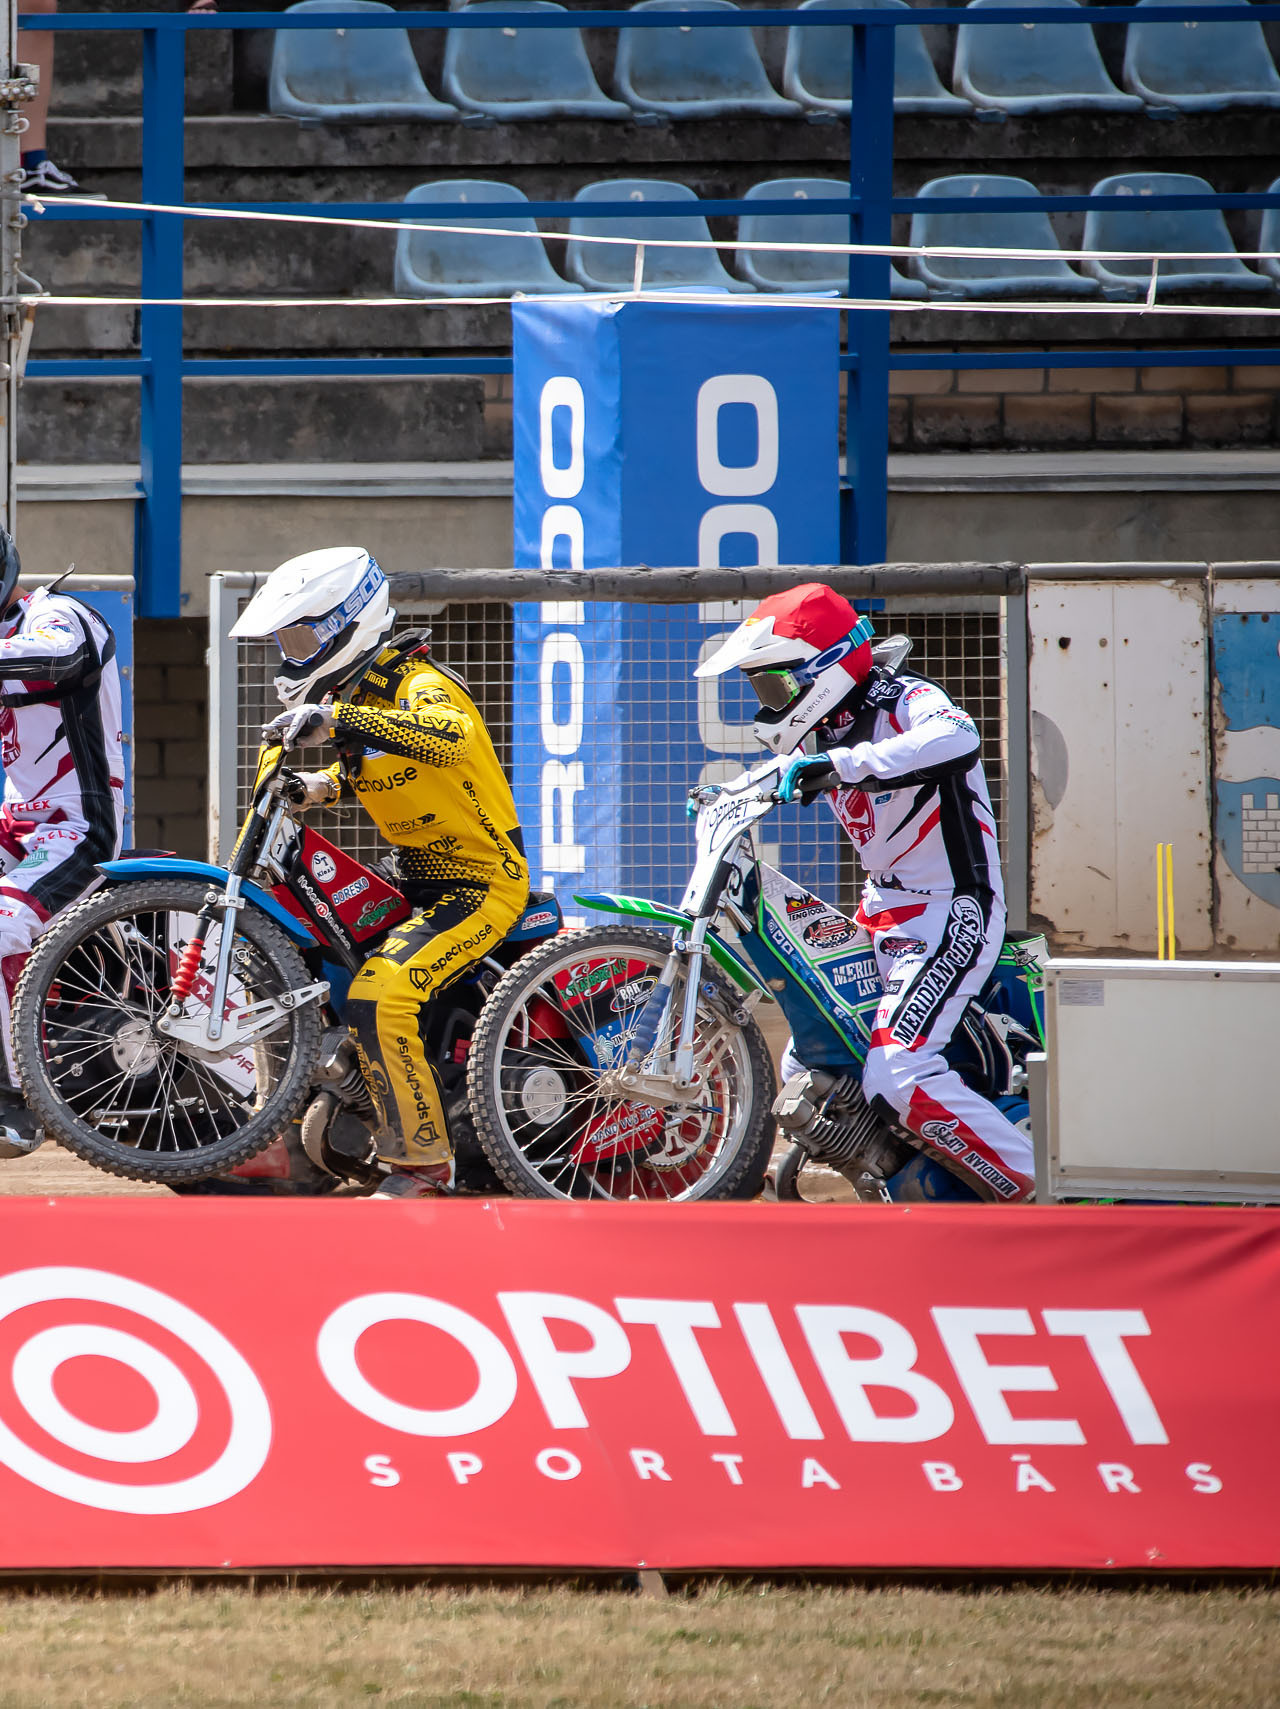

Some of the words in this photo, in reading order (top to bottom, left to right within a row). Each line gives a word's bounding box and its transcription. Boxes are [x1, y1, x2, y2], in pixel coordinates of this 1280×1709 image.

[697, 374, 779, 873] ODO
[539, 375, 586, 928] RODO
[350, 766, 418, 793] chouse
[384, 817, 419, 834] Imex
[463, 780, 511, 860] spechouse
[332, 877, 369, 906] BORESKO
[396, 893, 457, 934] OL-CAR
[832, 958, 879, 986] MERID
[856, 975, 881, 997] LIF
[892, 957, 956, 1047] MERIDIAN
[397, 1036, 431, 1120] spechouse
[964, 1152, 1018, 1197] MERIDIAN
[316, 1291, 1169, 1445] OPTIBET
[363, 1447, 841, 1490] SPORTA
[922, 1454, 1223, 1495] BĀRS
